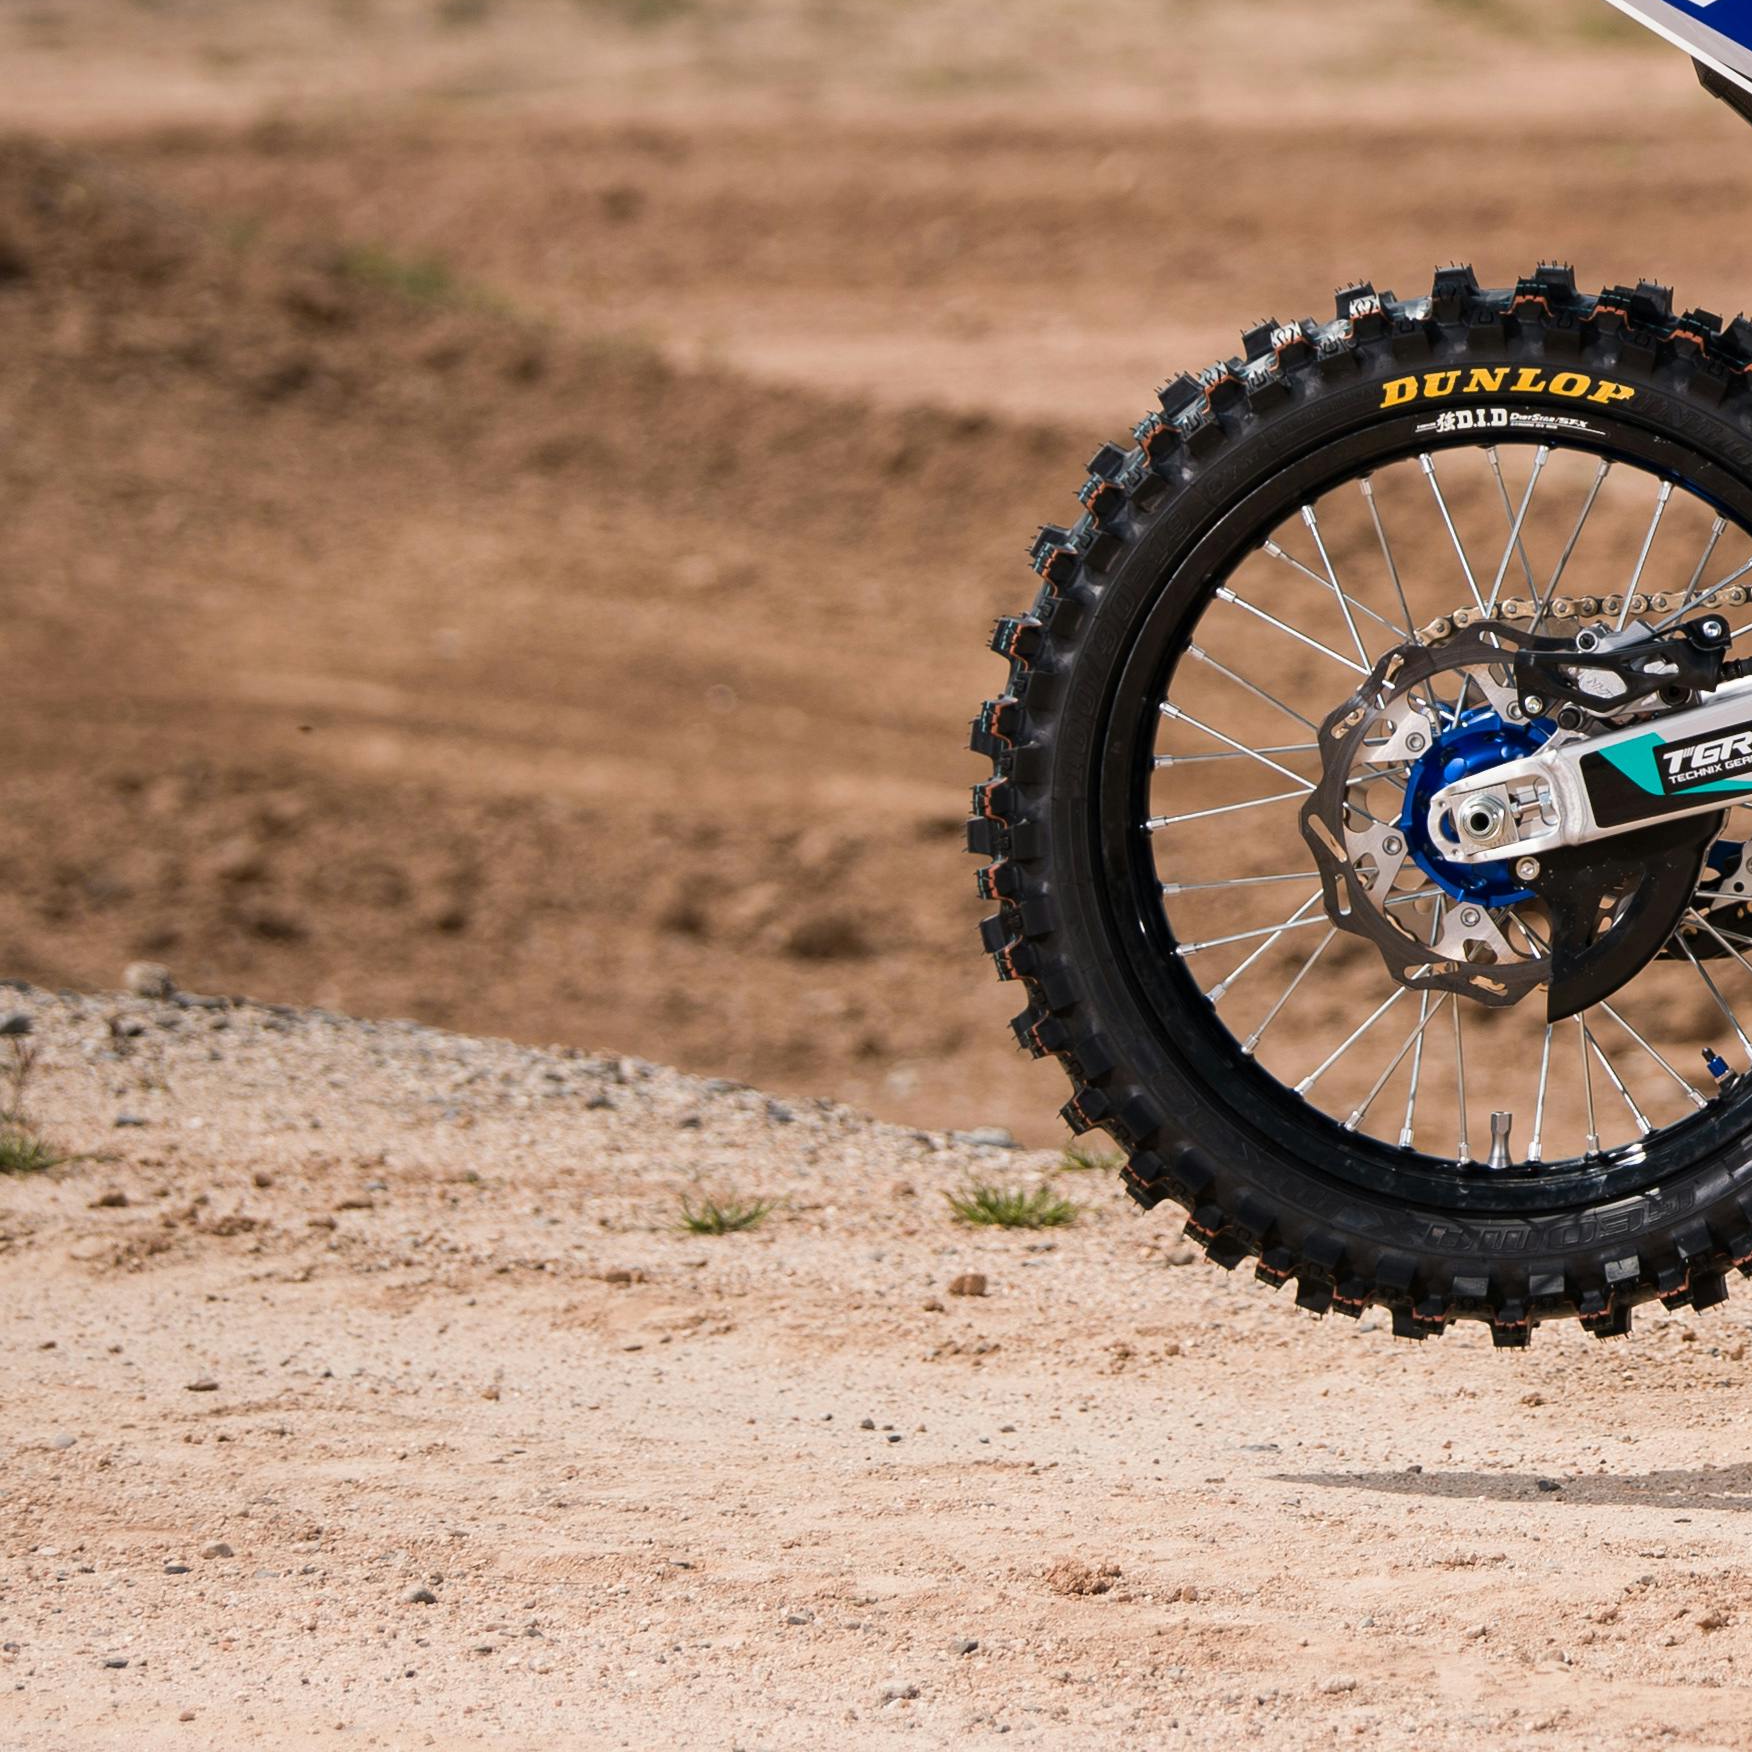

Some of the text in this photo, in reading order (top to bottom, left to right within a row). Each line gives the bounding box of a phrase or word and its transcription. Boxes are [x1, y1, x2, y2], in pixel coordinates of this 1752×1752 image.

[1379, 366, 1636, 409] DUNLOP
[1456, 407, 1508, 429] D.I.D
[1667, 764, 1723, 785] TECHNIX
